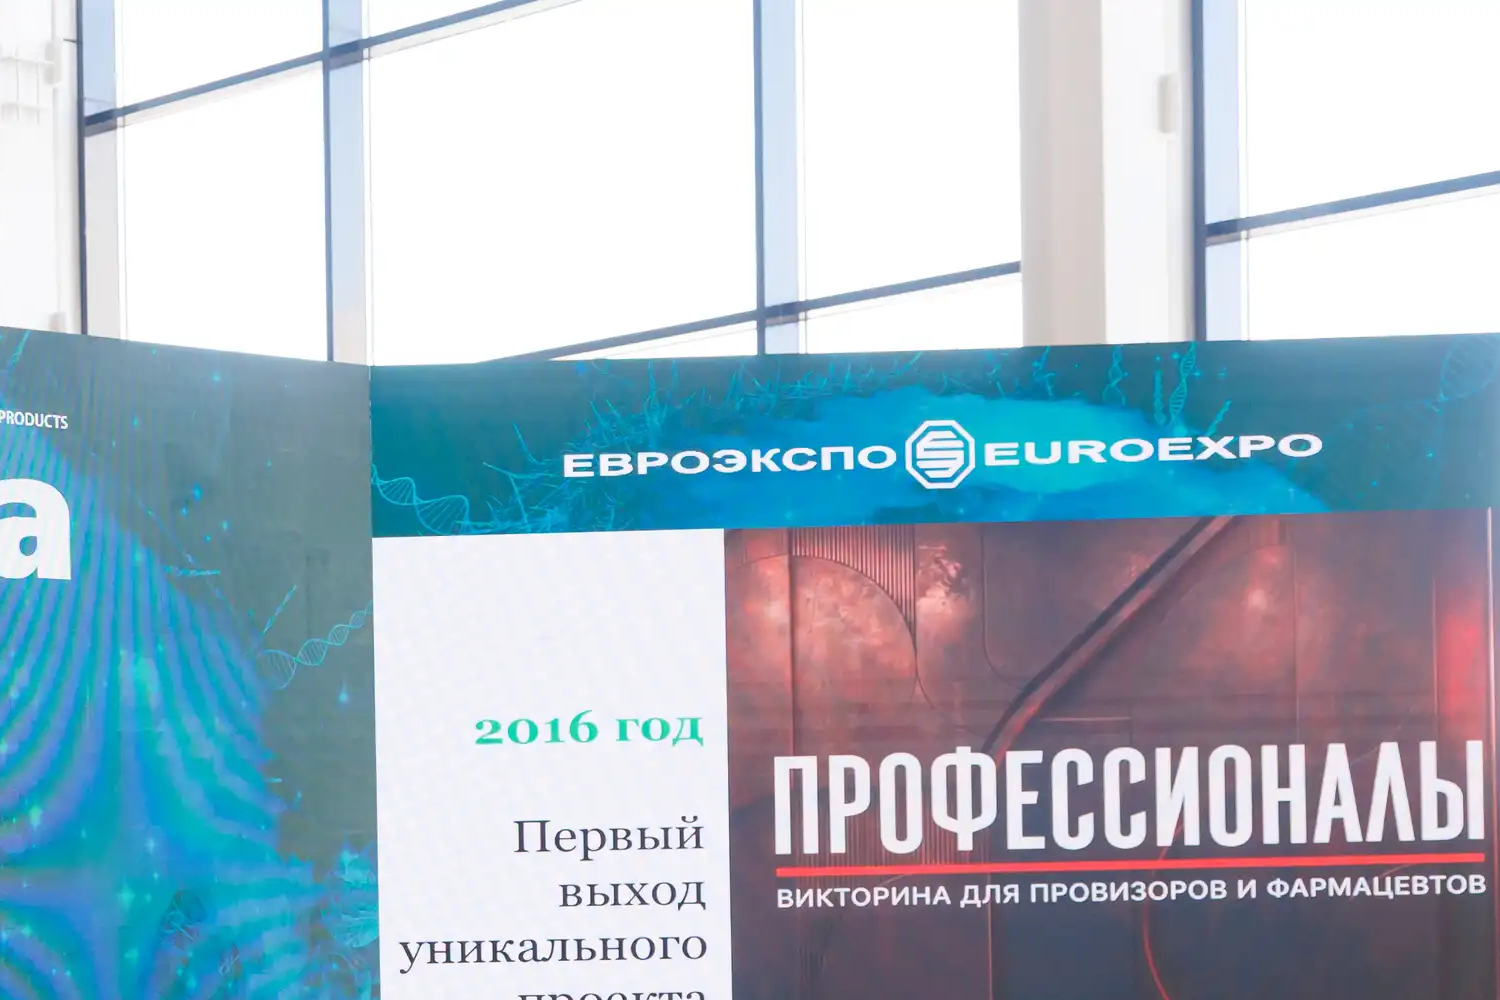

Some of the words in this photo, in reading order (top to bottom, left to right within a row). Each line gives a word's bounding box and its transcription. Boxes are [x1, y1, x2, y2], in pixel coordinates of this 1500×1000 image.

[563, 445, 896, 478] ЕВРОЭКСПО
[984, 433, 1323, 467] EUROEXPO
[474, 709, 599, 745] 2016
[615, 716, 704, 747] год
[773, 739, 1485, 856] ПРОФЕССИОНАЛЫ
[513, 815, 704, 861] Первый
[558, 881, 707, 911] выход
[777, 885, 952, 909] ВИКТОРИНА
[960, 884, 1020, 909] ДЛЯ
[1030, 878, 1227, 904] ПРОВИЗОРОВ
[1237, 880, 1258, 899] И
[1266, 874, 1487, 901] ФАРМАЦЕВТОВ
[399, 935, 708, 975] уникального
